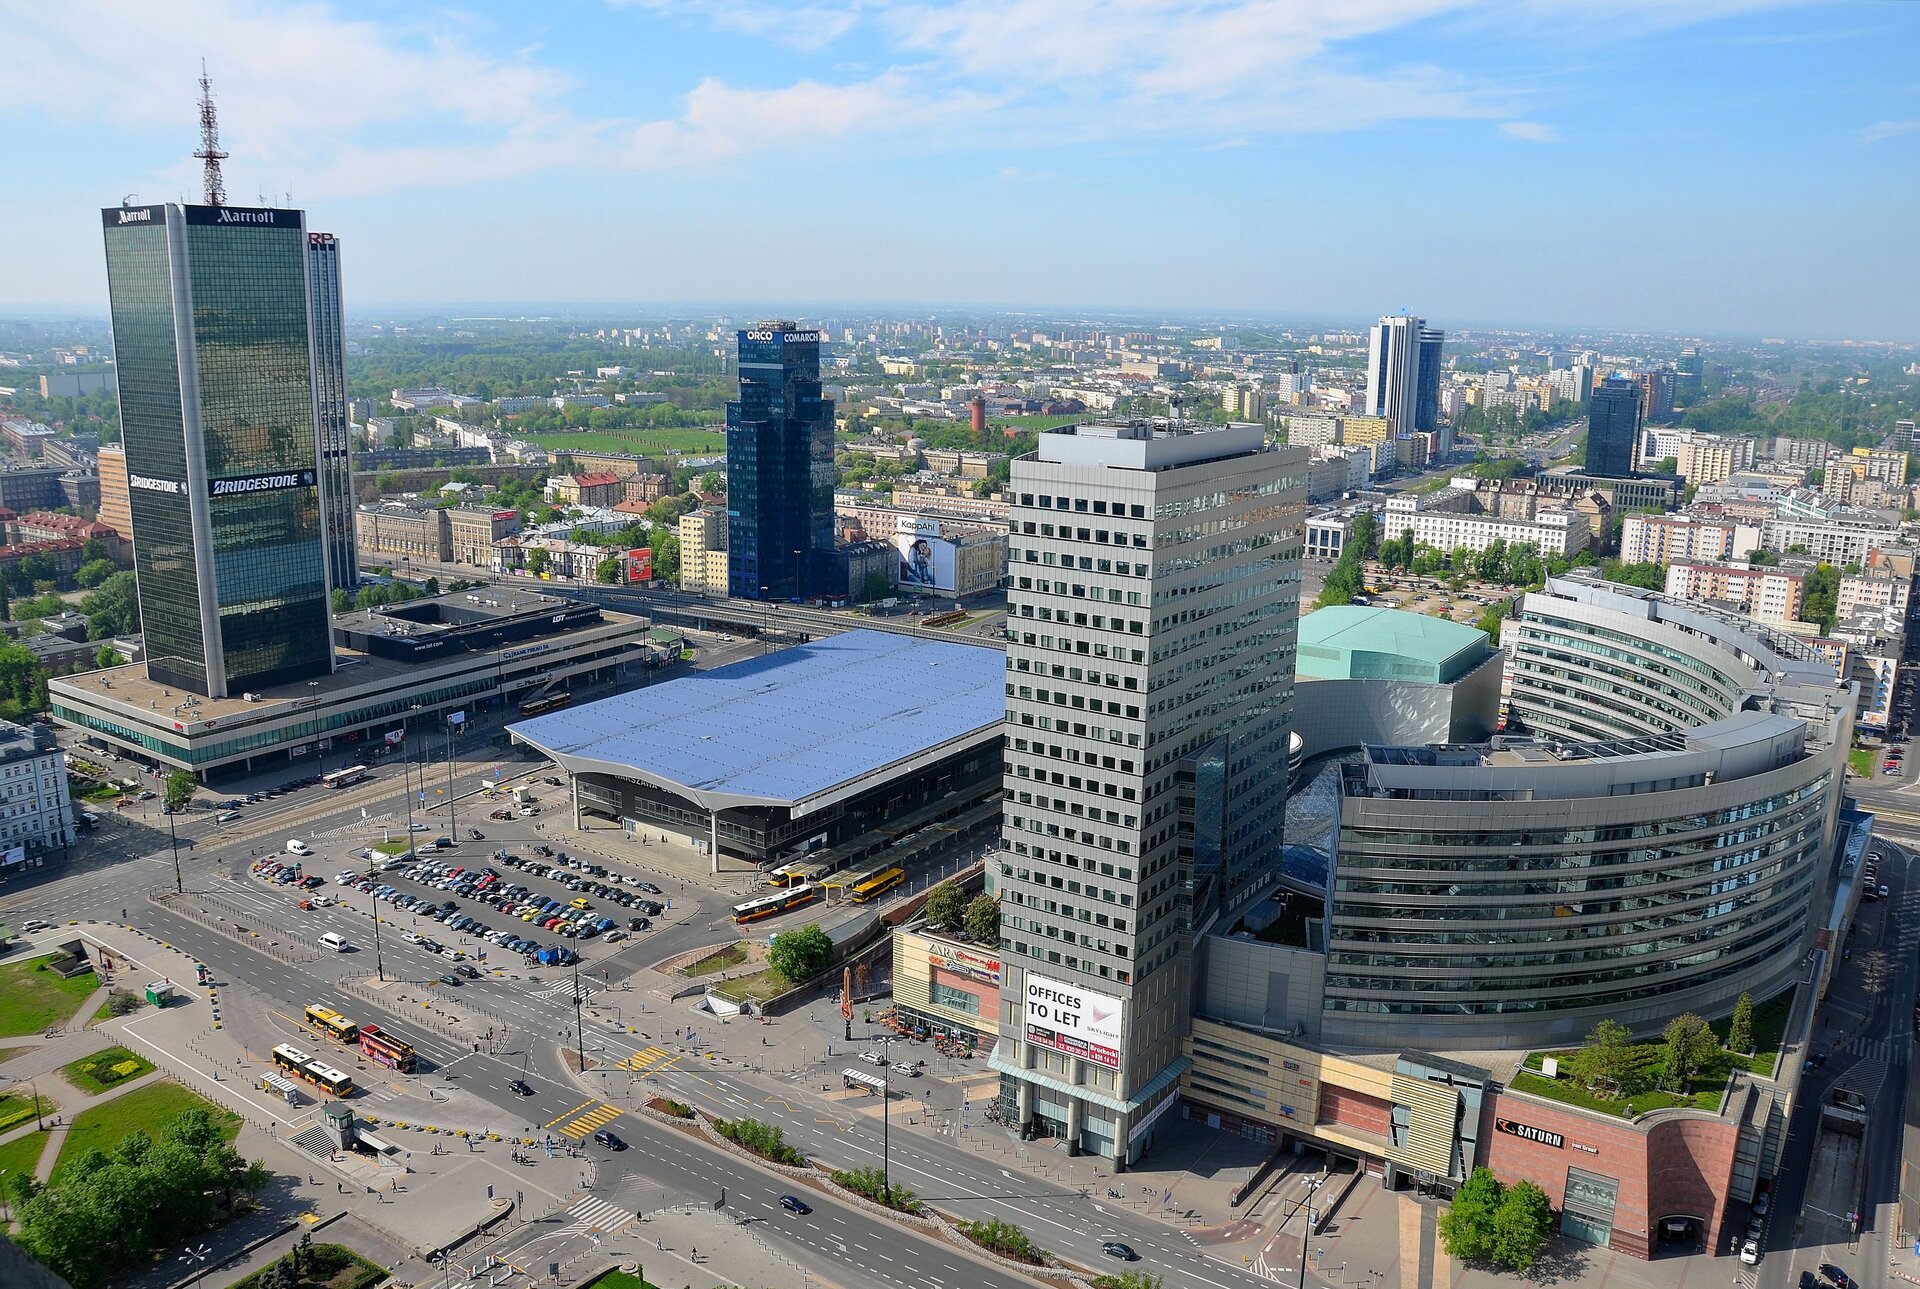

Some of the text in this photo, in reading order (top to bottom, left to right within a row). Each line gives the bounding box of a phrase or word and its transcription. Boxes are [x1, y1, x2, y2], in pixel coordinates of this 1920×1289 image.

[118, 208, 151, 225] Marriott
[217, 208, 274, 224] Marriott
[747, 331, 773, 341] ORCO
[783, 332, 818, 343] COMARCH
[130, 474, 179, 494] BRIDGESTONE
[213, 474, 299, 495] BRIDGESTONE
[901, 520, 935, 532] KappAhl
[552, 614, 566, 624] LOT
[927, 943, 958, 960] ZARA
[1028, 984, 1082, 1009] OFFICES
[1028, 1001, 1081, 1028] TO LET
[1086, 1026, 1119, 1040] SKYLIGHT
[1517, 1125, 1562, 1147] SATURN
